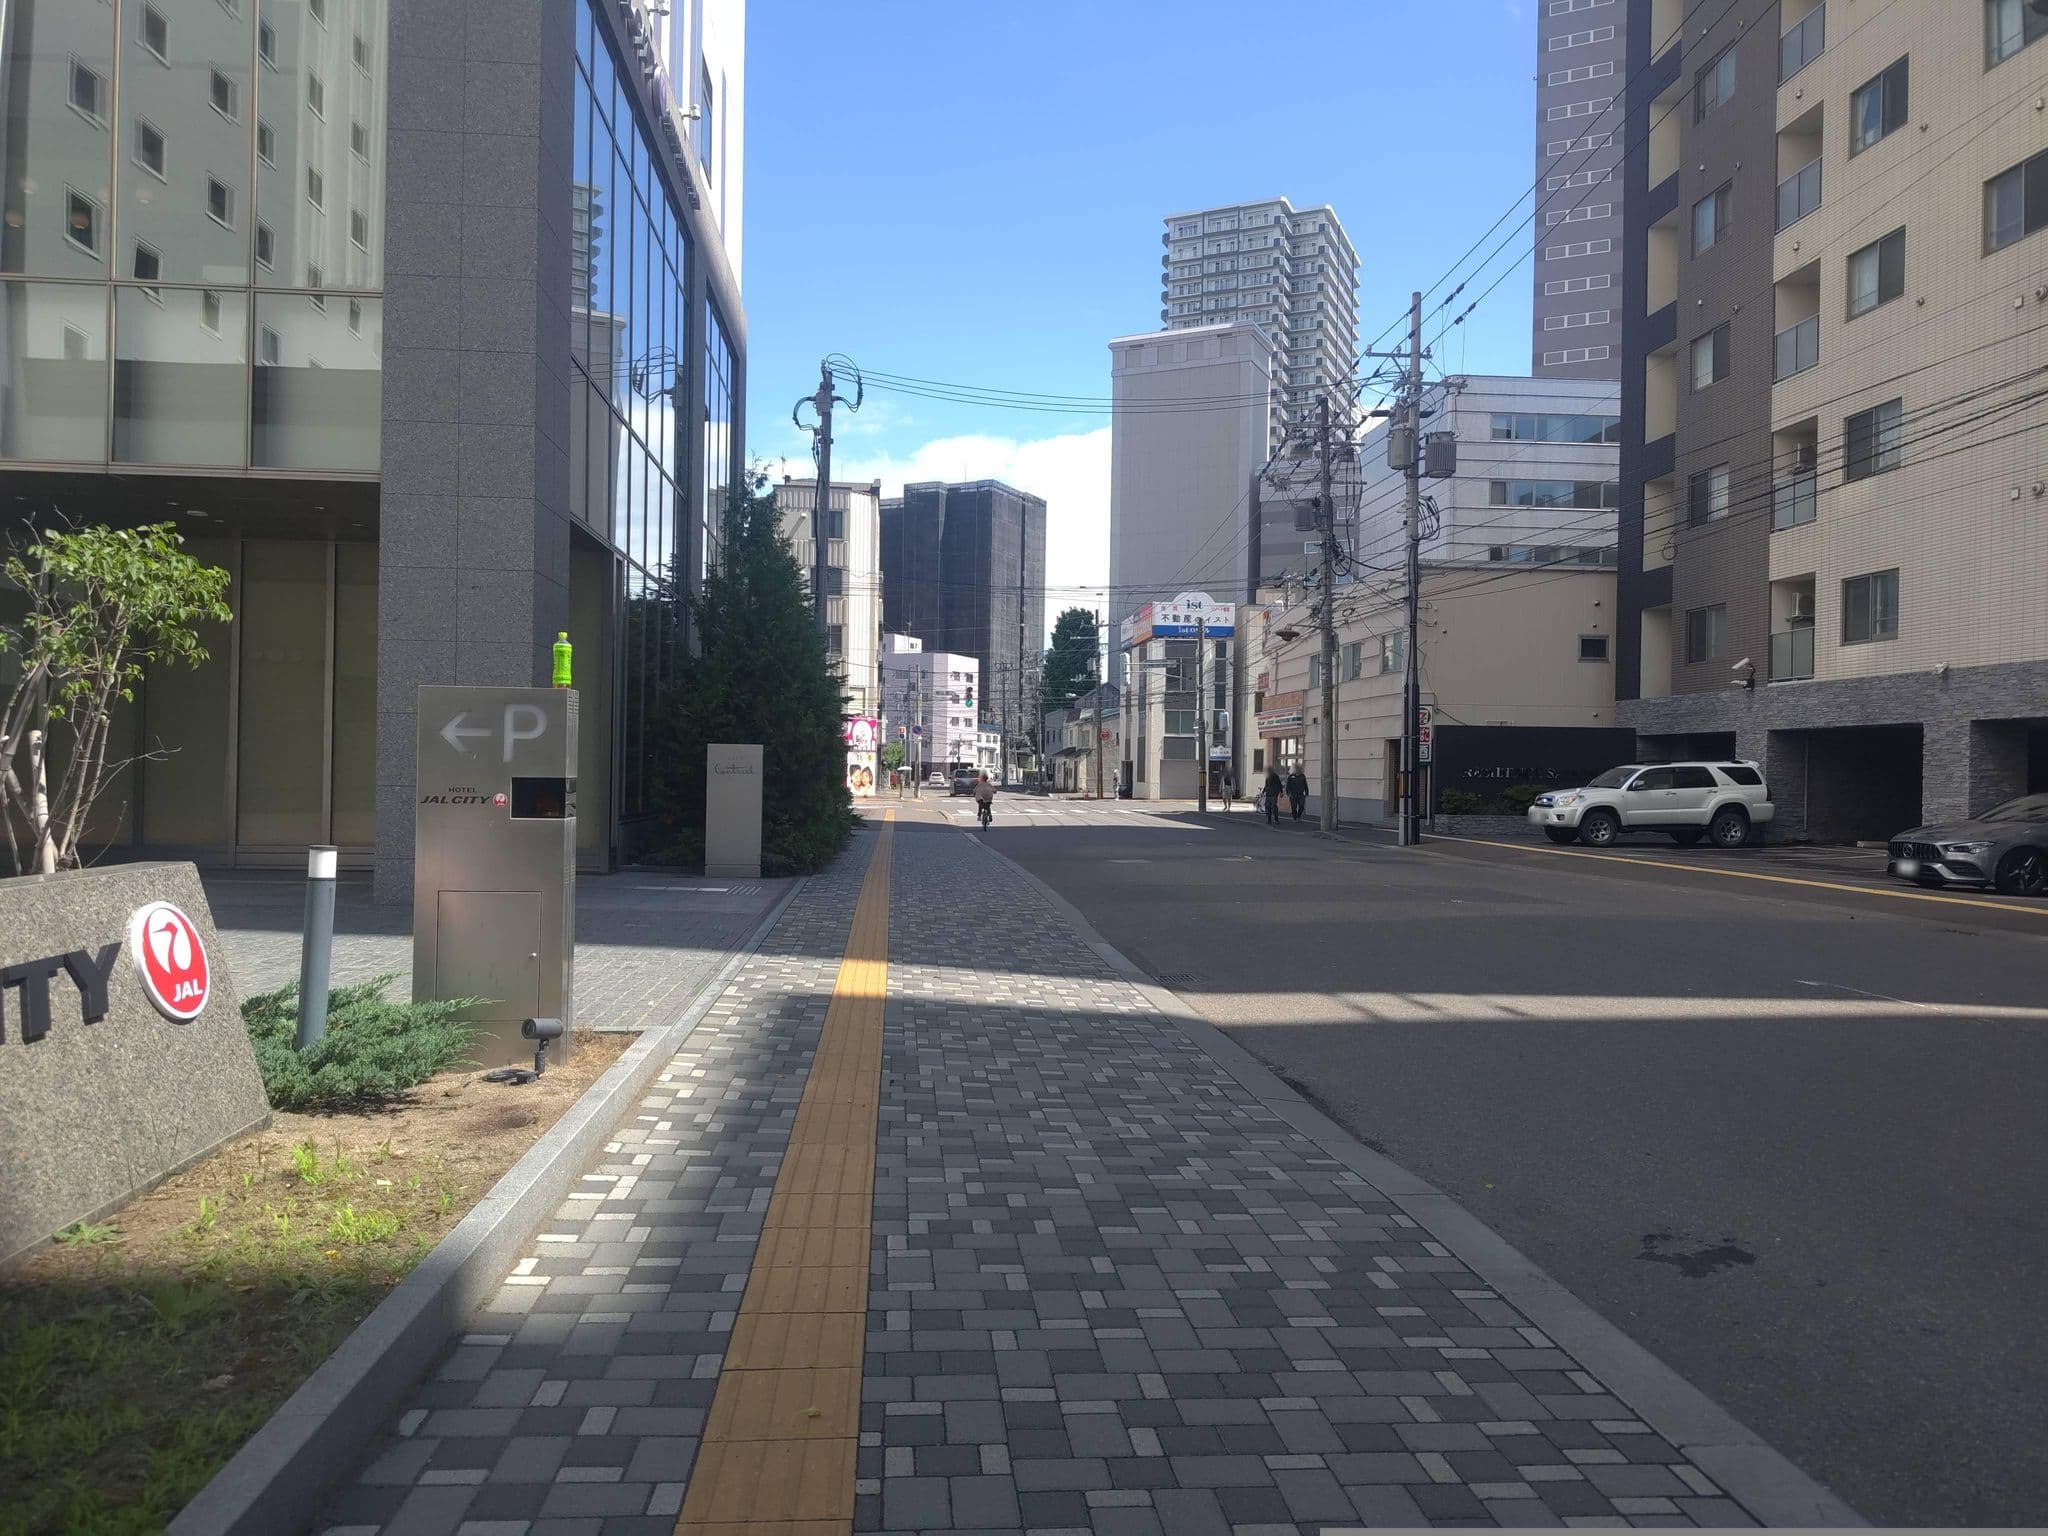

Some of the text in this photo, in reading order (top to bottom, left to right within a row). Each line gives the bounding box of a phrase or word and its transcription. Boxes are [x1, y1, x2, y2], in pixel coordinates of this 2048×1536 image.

[1186, 599, 1203, 609] ist
[503, 703, 548, 763] P
[0, 942, 123, 1045] TY
[173, 979, 204, 1002] JAL
